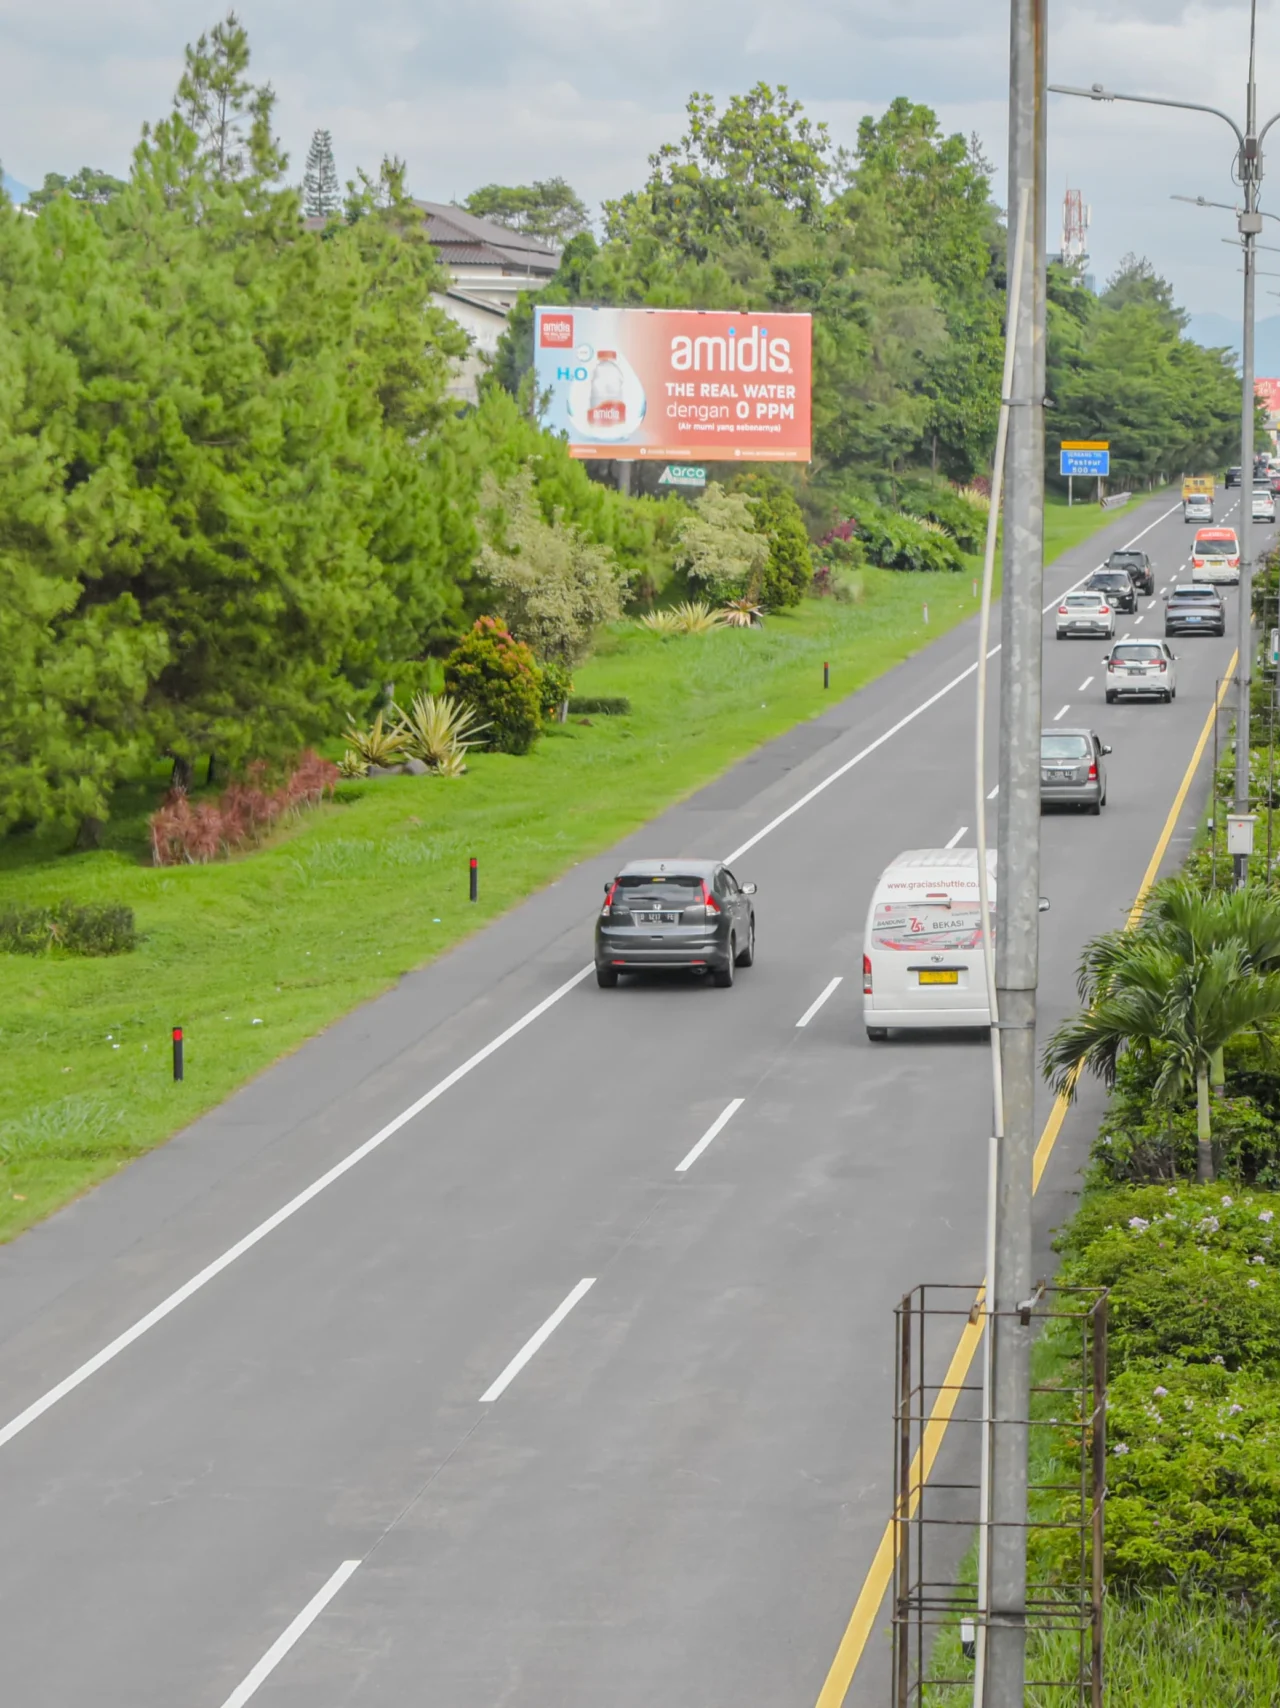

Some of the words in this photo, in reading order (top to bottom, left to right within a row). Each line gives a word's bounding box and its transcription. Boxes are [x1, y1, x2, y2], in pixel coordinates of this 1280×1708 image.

[543, 321, 571, 333] amidis
[671, 325, 790, 373] amidis
[665, 382, 695, 397] THE
[700, 383, 738, 398] REAL
[743, 384, 796, 399] WATER
[666, 401, 730, 422] dengan
[735, 400, 750, 419] 0
[756, 403, 795, 420] PPM
[717, 423, 734, 433] yang
[1068, 458, 1101, 466] Pasteur
[672, 467, 705, 477] arco
[877, 918, 906, 927] BANDUNG
[932, 920, 964, 930] BEKASI
